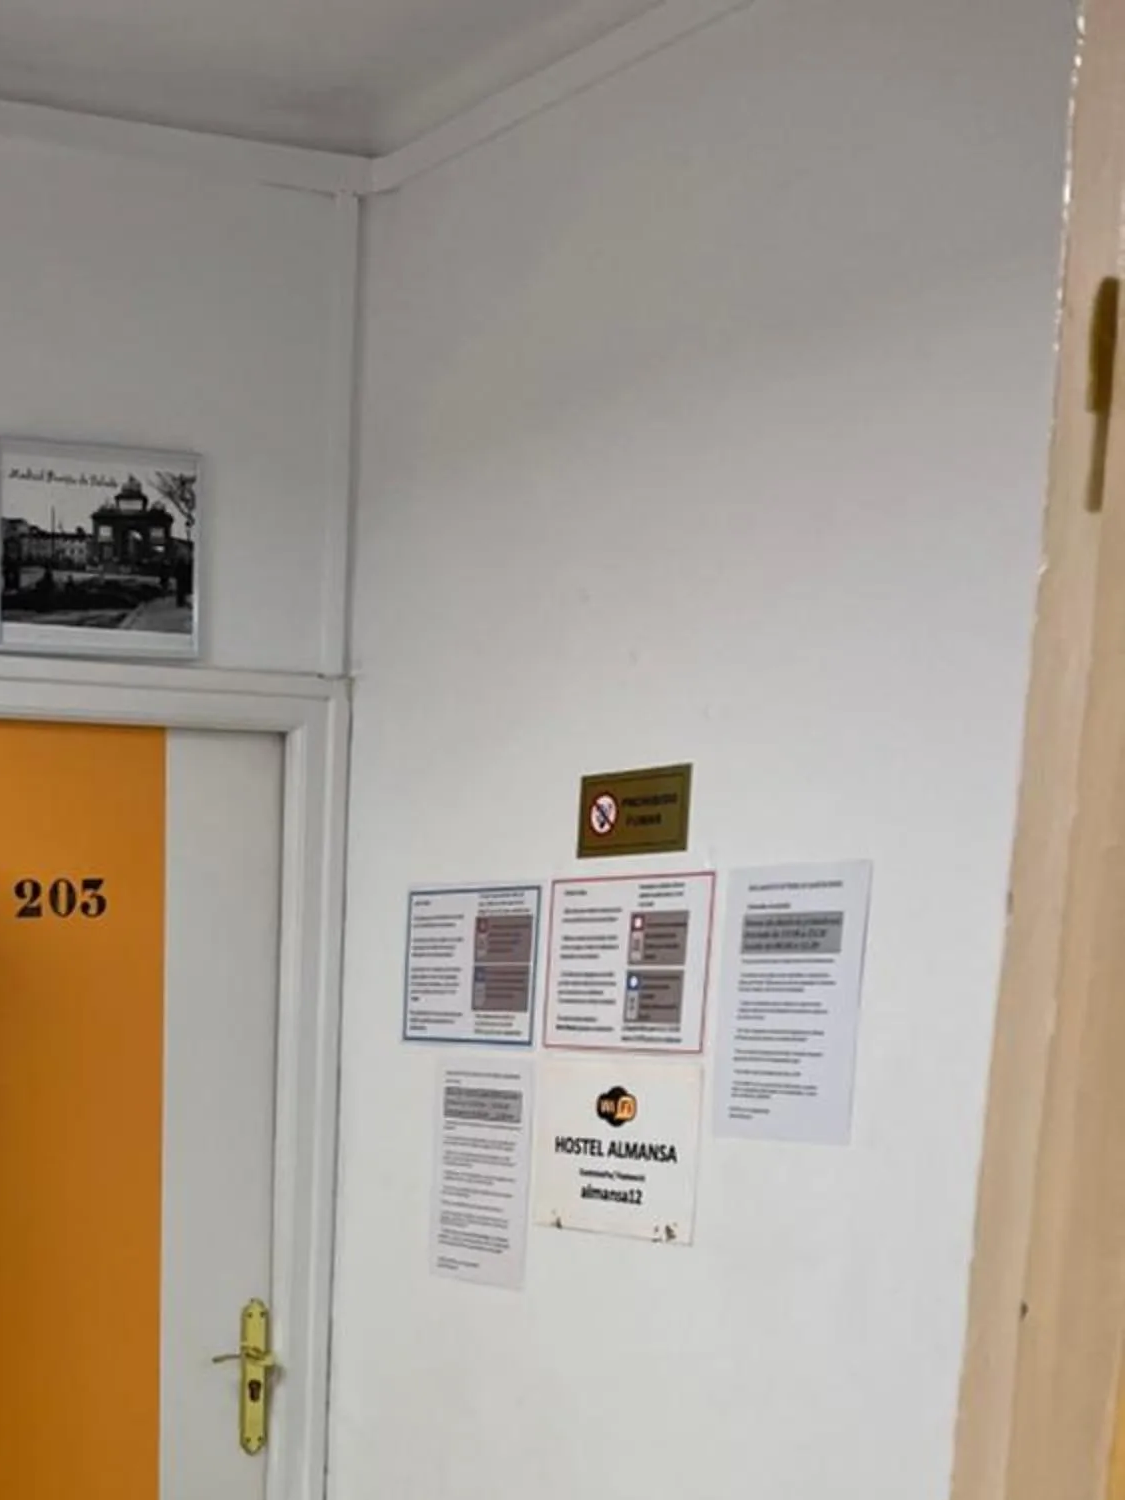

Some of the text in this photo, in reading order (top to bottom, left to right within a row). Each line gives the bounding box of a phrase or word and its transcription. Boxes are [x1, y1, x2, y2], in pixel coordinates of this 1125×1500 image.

[555, 1135, 678, 1164] HOSTEL ALMANSA
[581, 1184, 643, 1205] almansa12
